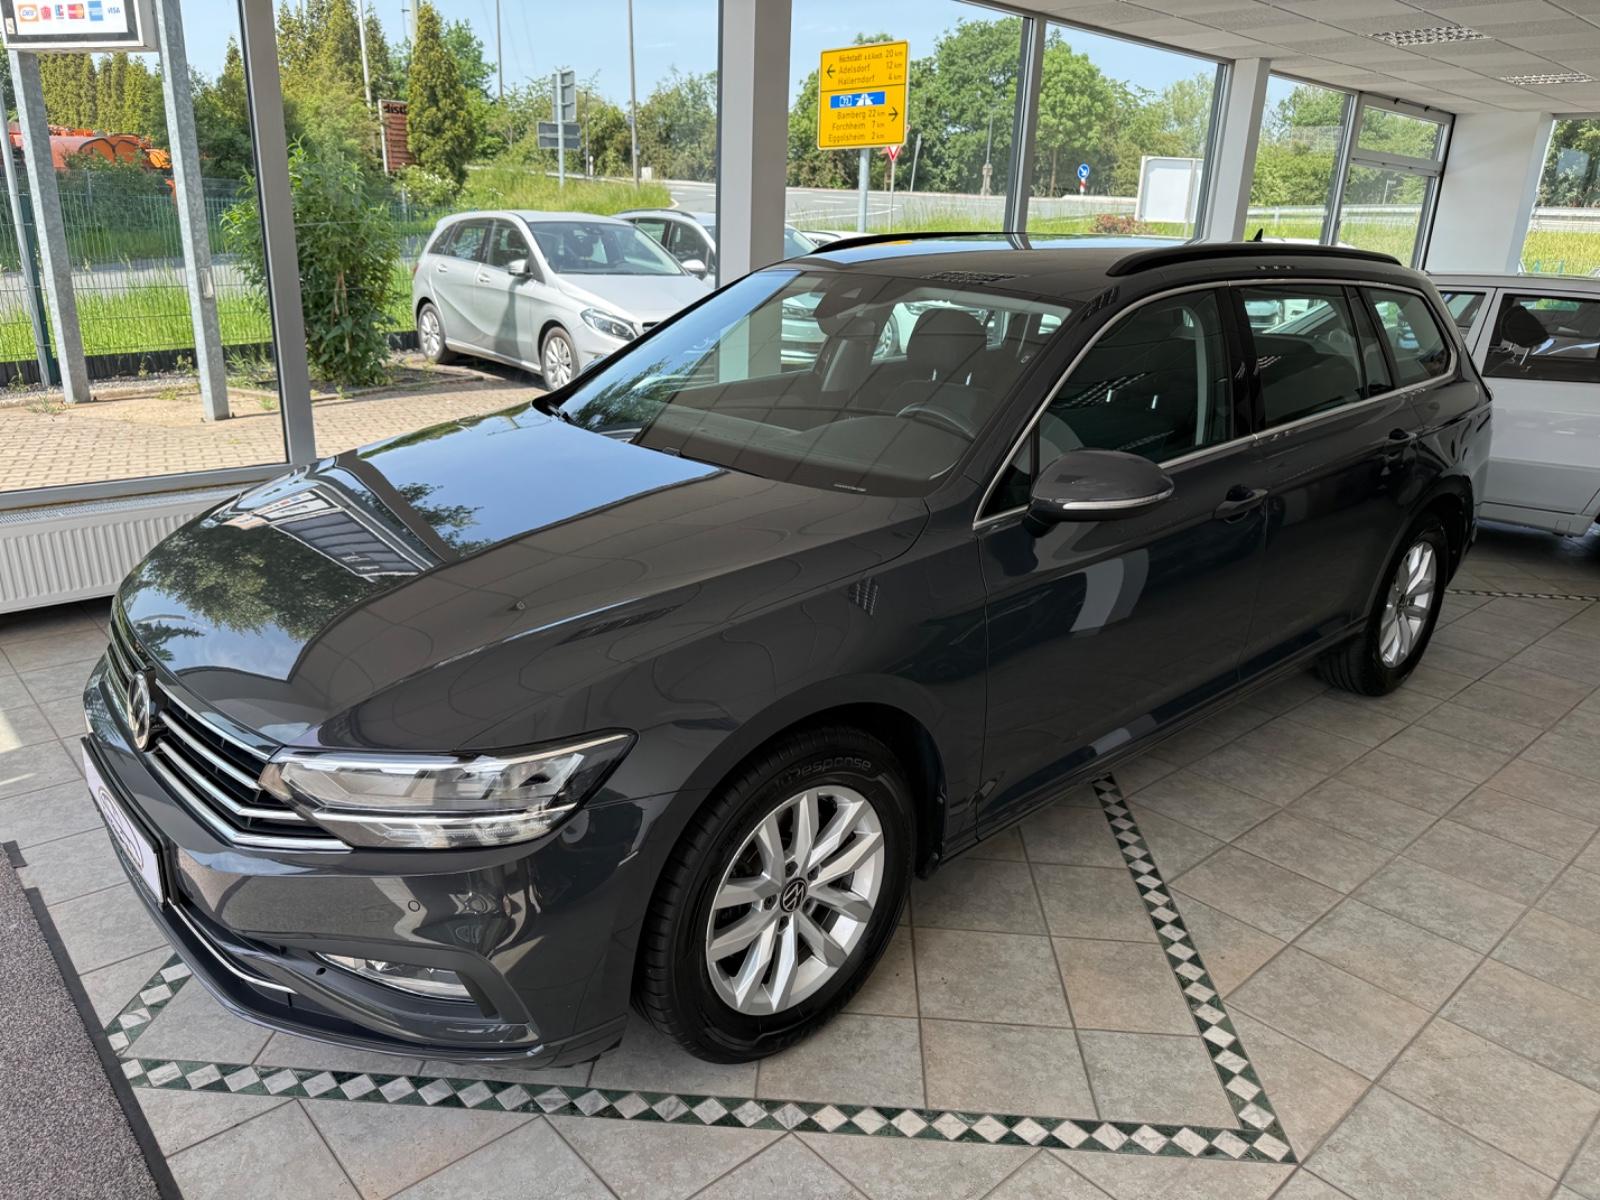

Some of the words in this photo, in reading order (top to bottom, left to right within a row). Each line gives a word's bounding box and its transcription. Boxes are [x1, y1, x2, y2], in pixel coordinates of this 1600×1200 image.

[885, 49, 893, 58] 20
[839, 64, 870, 74] Adelsdorf
[886, 61, 893, 69] 12
[837, 111, 866, 120] Bamberg
[868, 109, 876, 117] 22
[832, 122, 866, 131] Forchheim
[828, 133, 865, 143] Eggolsheim
